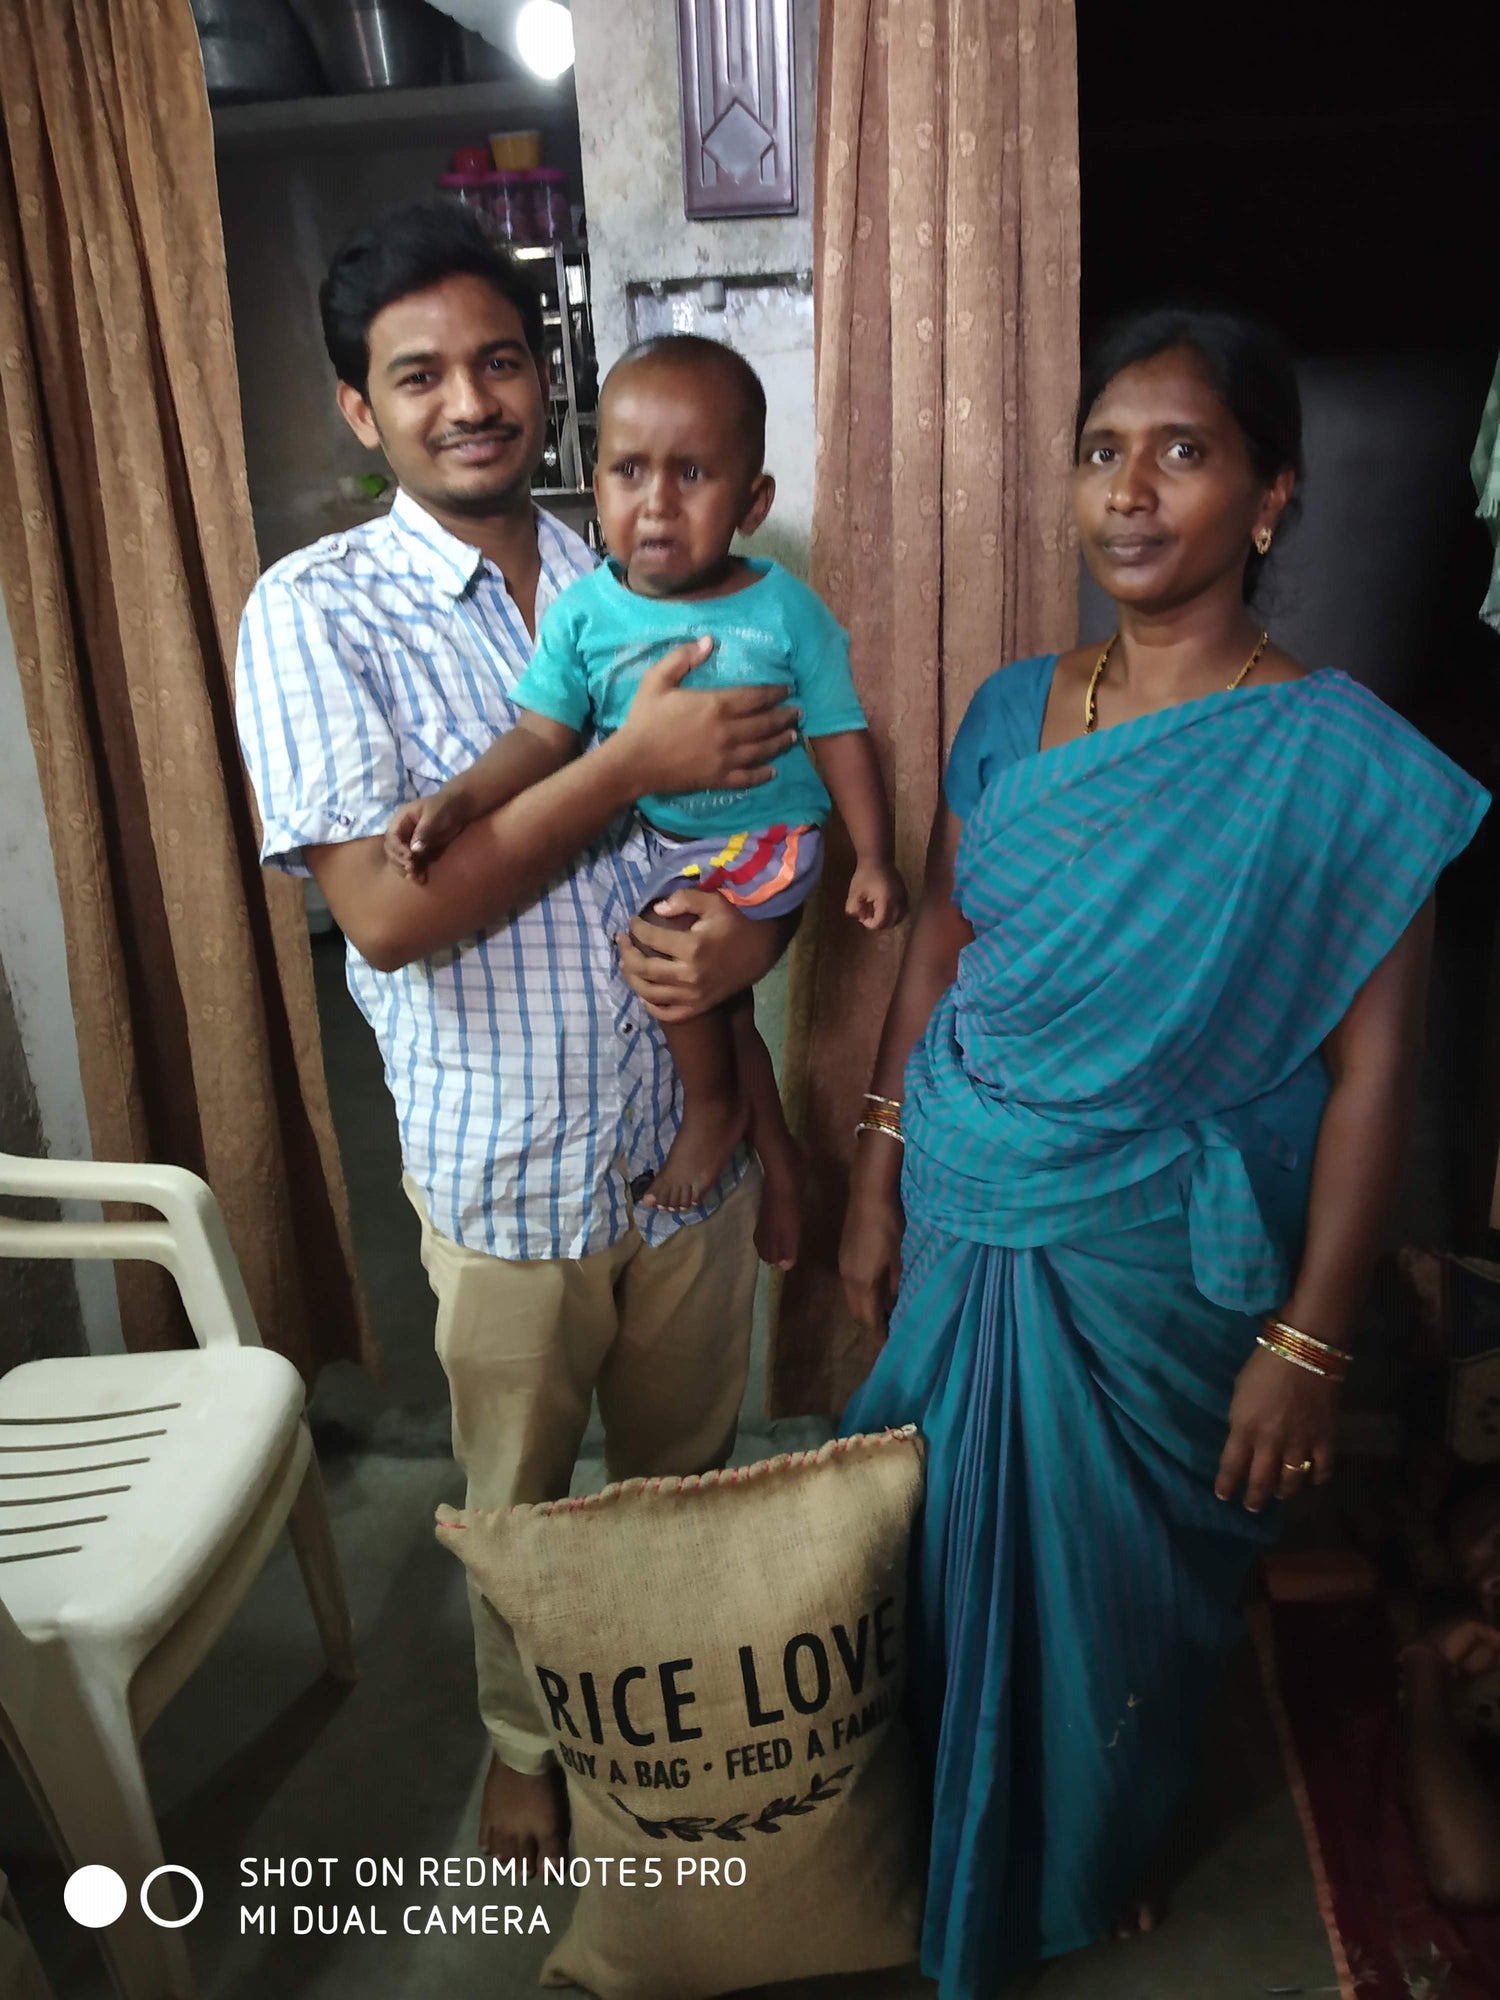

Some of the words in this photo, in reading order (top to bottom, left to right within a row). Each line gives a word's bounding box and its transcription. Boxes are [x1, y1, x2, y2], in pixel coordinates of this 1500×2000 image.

[535, 1657, 702, 1747] RICE
[738, 1597, 897, 1727] LOVE
[558, 1740, 596, 1779] BUY
[610, 1760, 627, 1785] A
[634, 1758, 690, 1789] BAG
[726, 1738, 793, 1780] FEED
[807, 1729, 825, 1761] A
